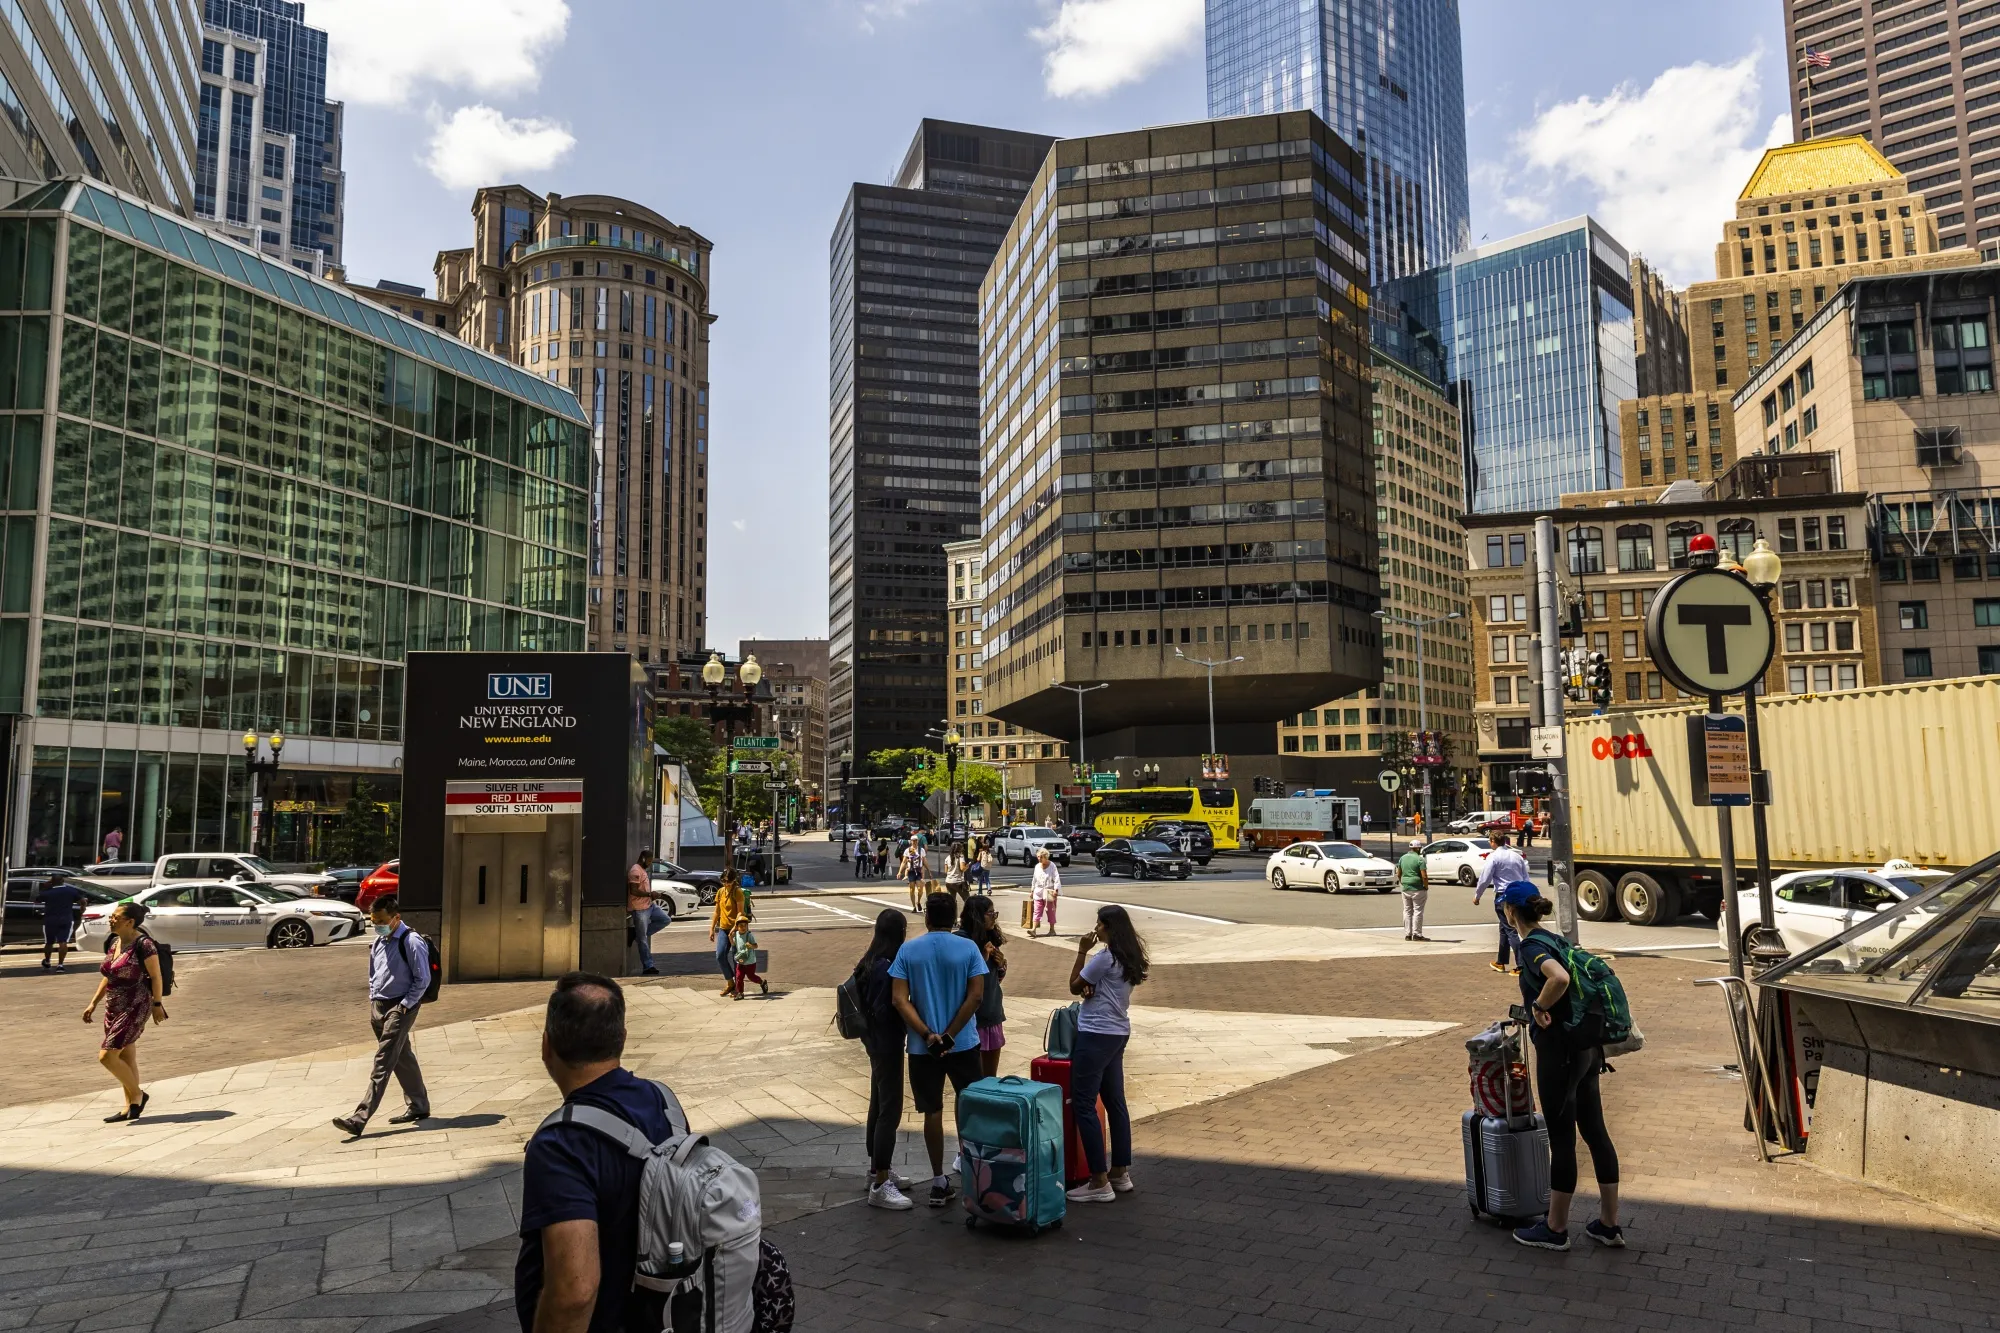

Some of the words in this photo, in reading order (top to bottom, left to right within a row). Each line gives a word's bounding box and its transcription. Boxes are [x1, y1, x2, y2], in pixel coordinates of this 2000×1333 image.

[1677, 603, 1752, 675] T
[492, 676, 547, 696] UNE
[474, 705, 546, 715] UNIVERSITY
[548, 705, 564, 715] OF
[460, 716, 497, 729] NEW
[500, 715, 577, 728] ENGLAND
[484, 734, 552, 743] www.une.edu
[1534, 733, 1559, 741] CHINATOWN
[735, 738, 766, 747] ATLANTIC
[1591, 733, 1653, 761] OOCL
[458, 758, 487, 768] Maine,
[489, 757, 529, 767] Morocco,
[530, 757, 546, 766] and
[547, 757, 576, 766] Online
[485, 783, 518, 792] SILVER
[523, 783, 545, 792] LINE
[1382, 776, 1397, 789] T
[491, 794, 511, 803] RED
[516, 793, 538, 802] LINE
[475, 805, 509, 814] SOUTH
[513, 804, 553, 813] STATION
[1269, 810, 1279, 820] THE
[1280, 810, 1299, 820] DINING
[1100, 816, 1136, 826] YANKEE
